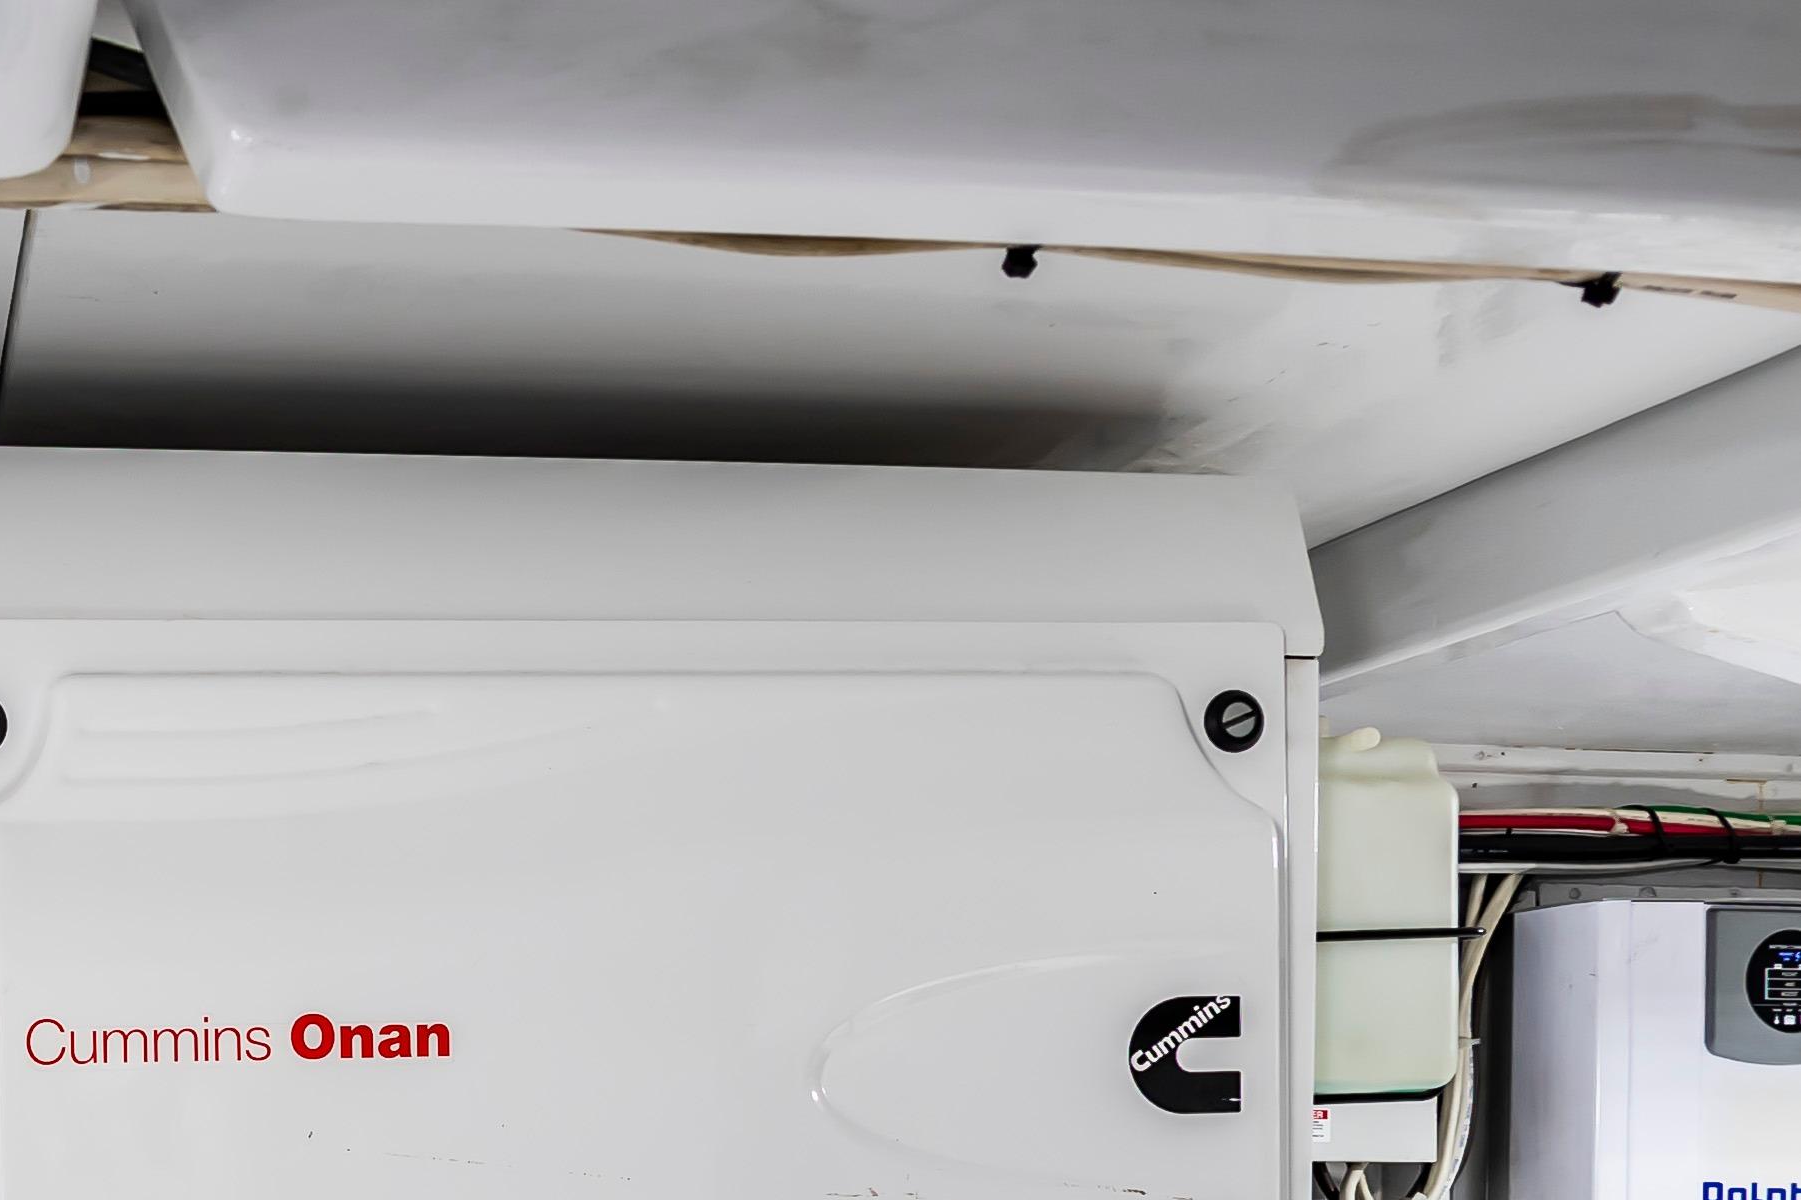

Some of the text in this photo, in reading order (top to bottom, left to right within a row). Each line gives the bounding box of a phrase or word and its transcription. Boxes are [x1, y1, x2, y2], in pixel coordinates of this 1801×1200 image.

[27, 1014, 450, 1065] Cummins Onan
[1131, 995, 1230, 1072] Cummins
